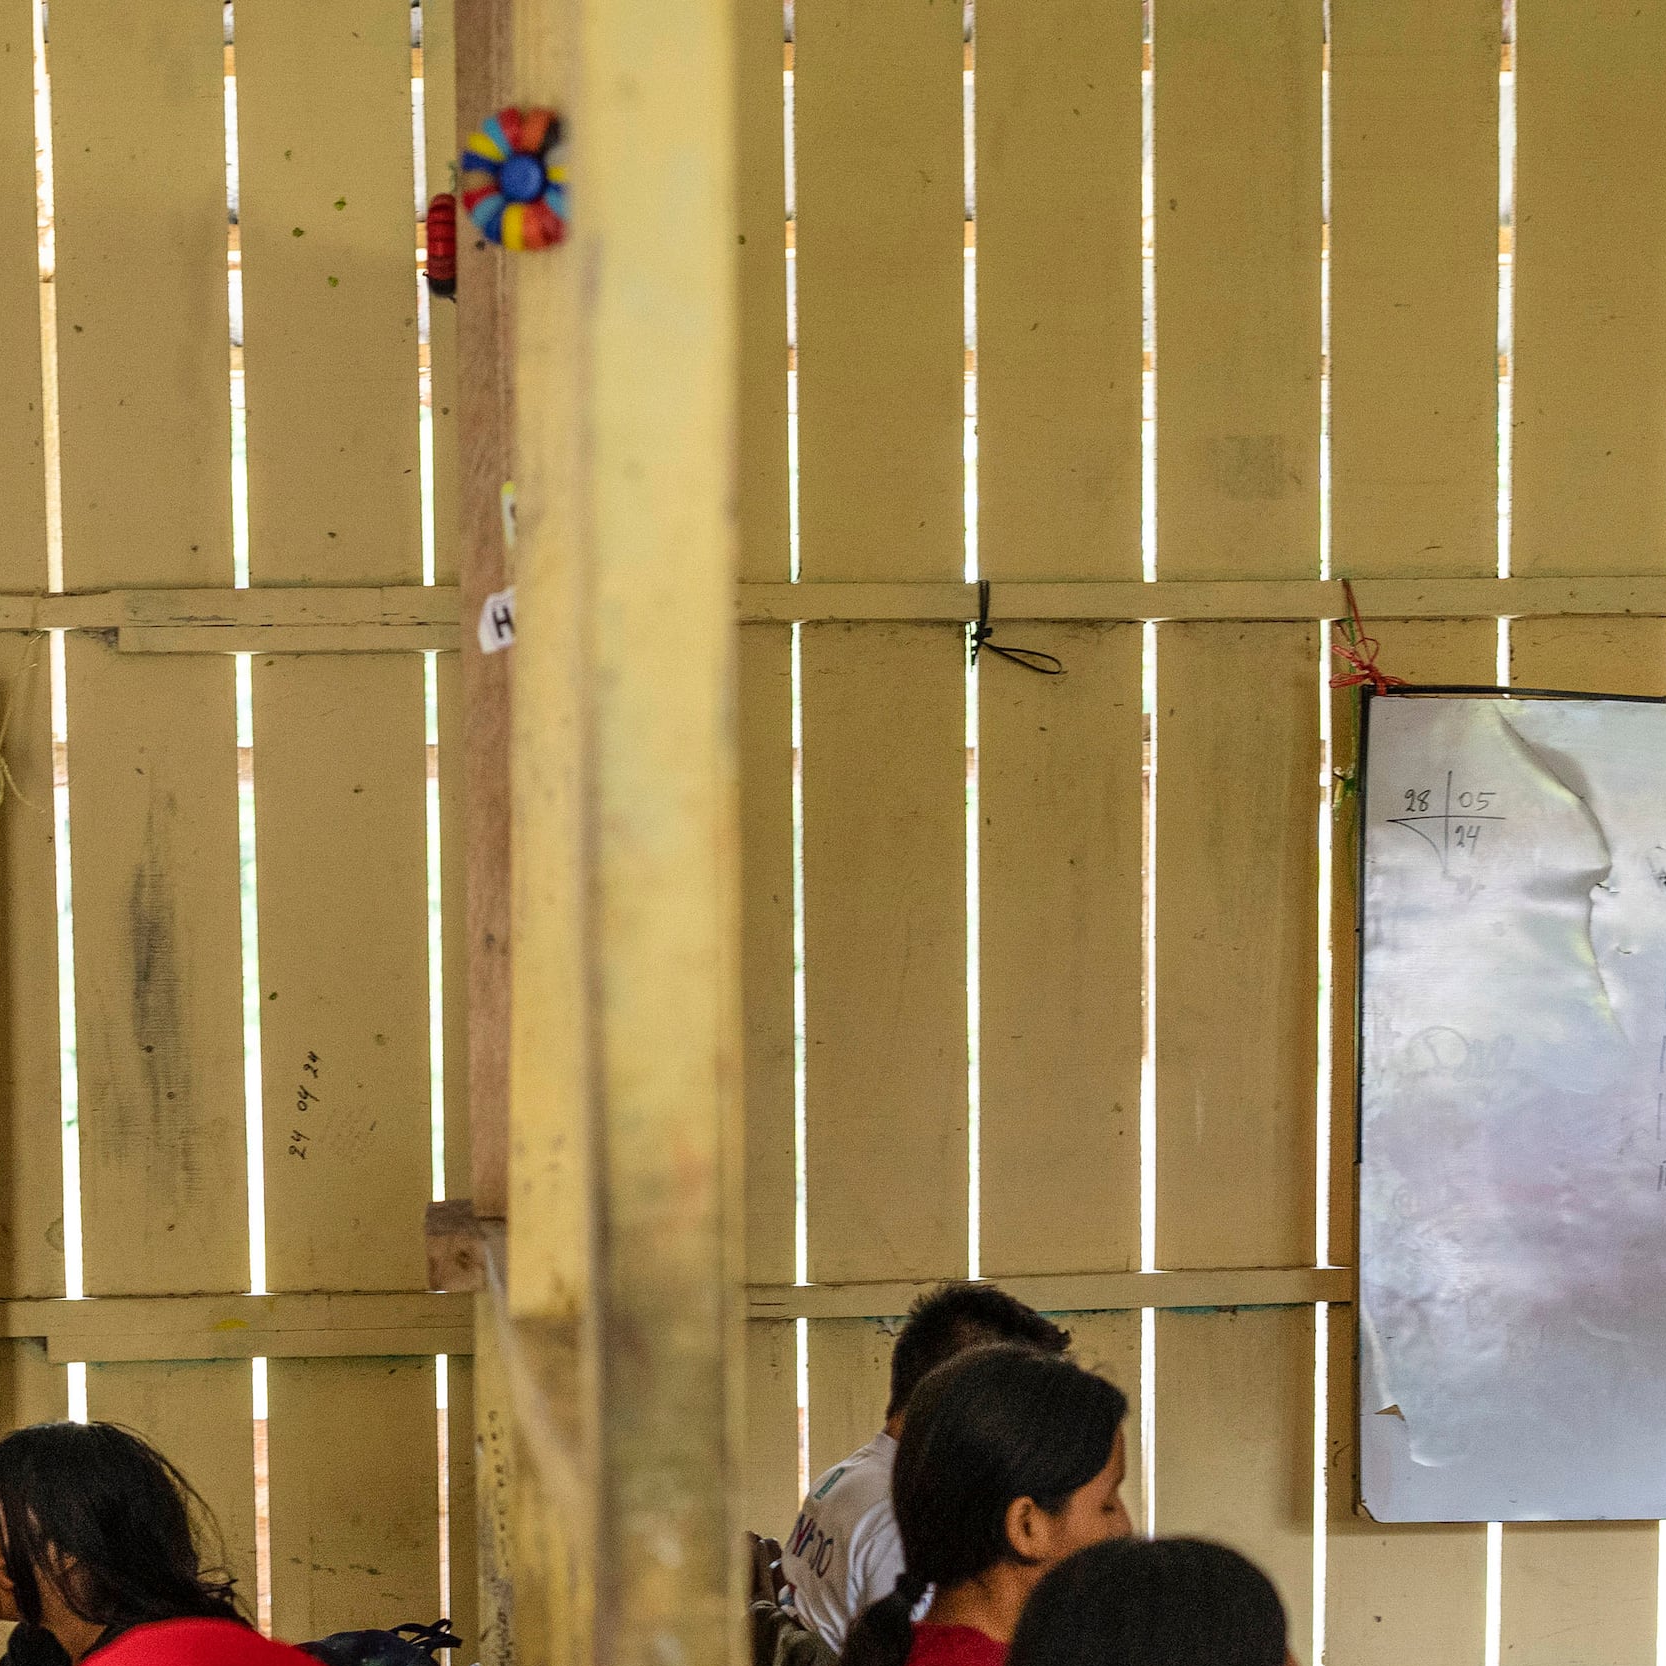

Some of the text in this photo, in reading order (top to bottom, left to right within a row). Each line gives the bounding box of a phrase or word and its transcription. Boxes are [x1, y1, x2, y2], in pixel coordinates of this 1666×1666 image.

[1404, 789, 1497, 812] 28 05
[1454, 824, 1481, 855] 24
